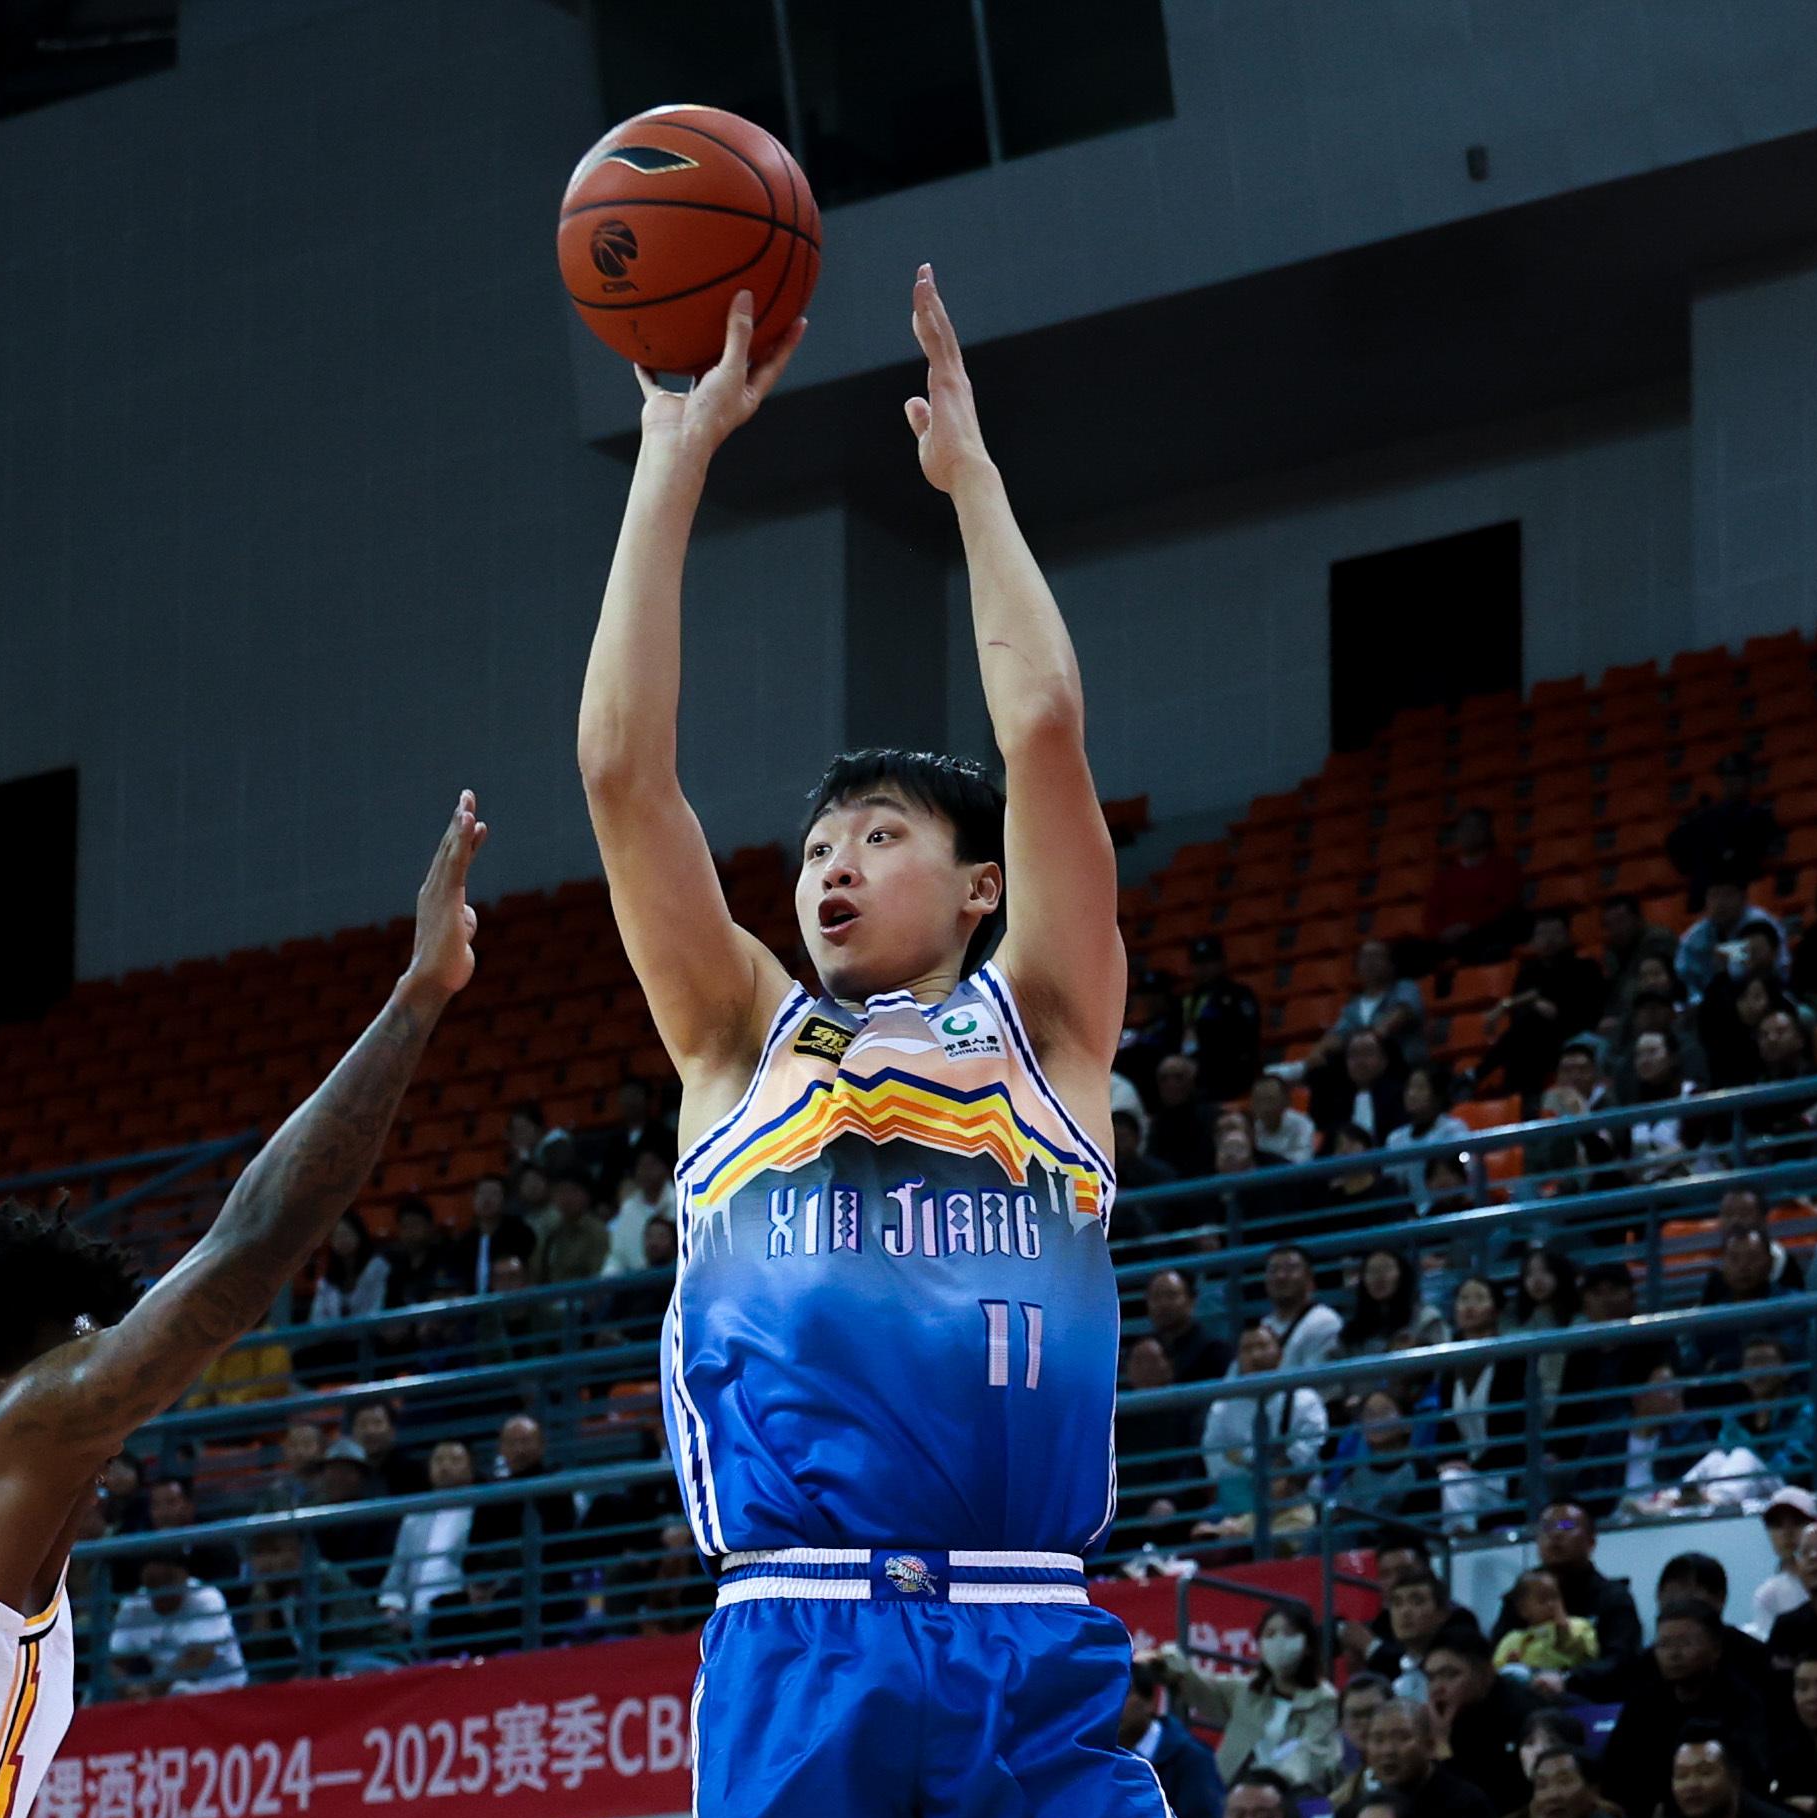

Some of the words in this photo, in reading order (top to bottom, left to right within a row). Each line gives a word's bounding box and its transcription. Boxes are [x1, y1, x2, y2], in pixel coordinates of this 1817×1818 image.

[944, 1035, 999, 1053] 中国人寿
[948, 1046, 980, 1058] CHINA
[979, 1299, 1042, 1390] 11
